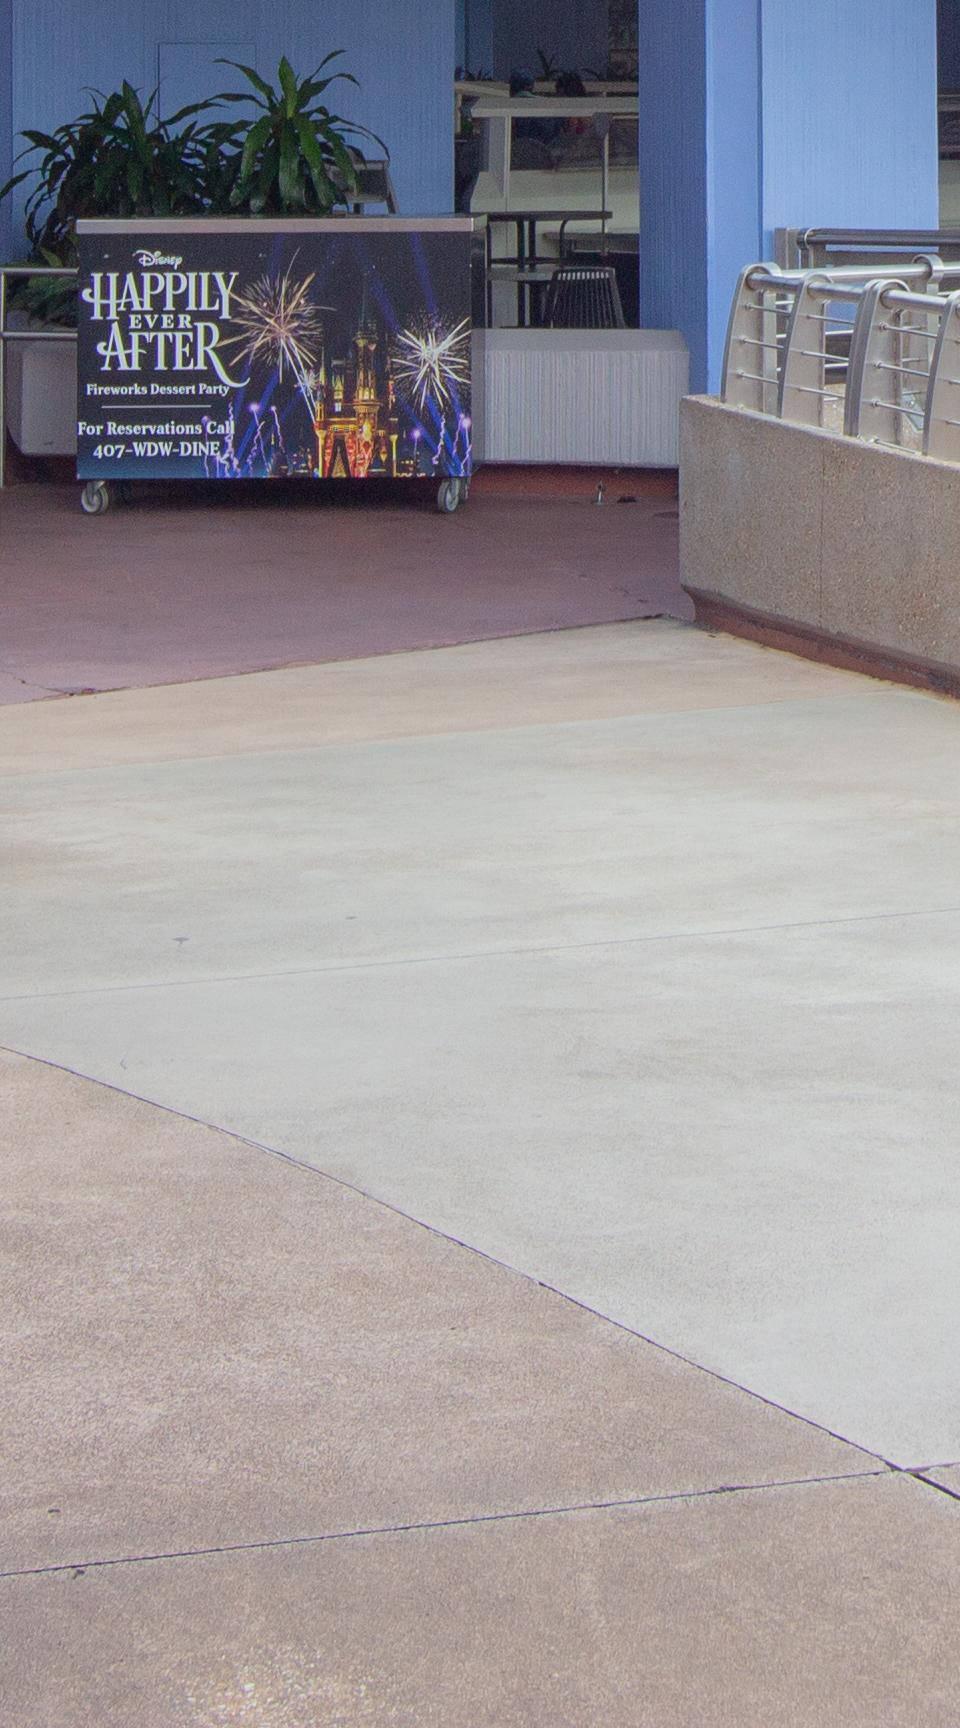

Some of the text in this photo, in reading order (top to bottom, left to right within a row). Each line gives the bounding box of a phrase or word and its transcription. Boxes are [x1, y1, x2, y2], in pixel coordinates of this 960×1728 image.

[132, 249, 183, 270] Disney
[81, 271, 239, 320] HAPPILY
[128, 313, 193, 329] EVER
[96, 320, 250, 388] AFTER
[86, 382, 230, 397] Fireworks Dessert Party
[78, 420, 235, 436] For Reservations Call
[92, 441, 220, 459] 407-WDW-DINE
